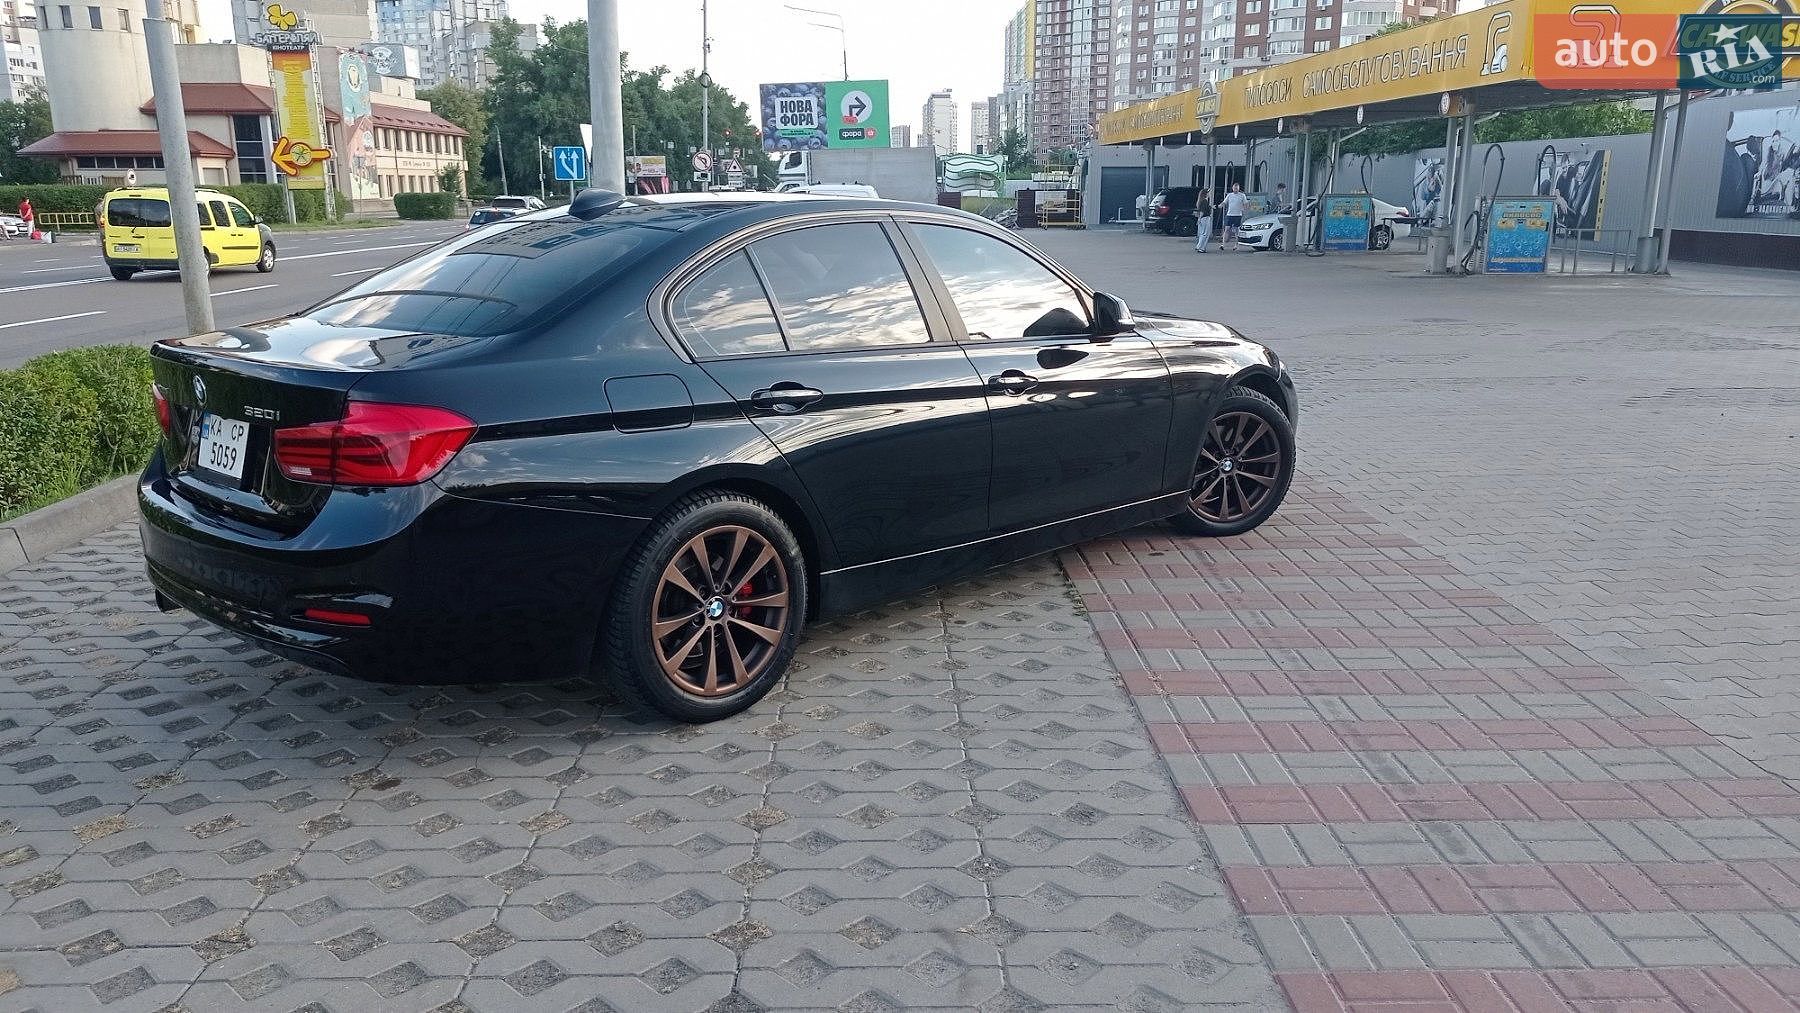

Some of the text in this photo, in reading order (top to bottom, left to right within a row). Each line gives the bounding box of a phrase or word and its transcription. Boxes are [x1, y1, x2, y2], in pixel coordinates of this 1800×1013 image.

[1302, 33, 1469, 98] САМООБСЛУГОВУВАННЯ
[780, 99, 813, 113] НОВА
[780, 113, 814, 126] ФОРА
[244, 405, 280, 421] 320i
[210, 441, 237, 471] 5059
